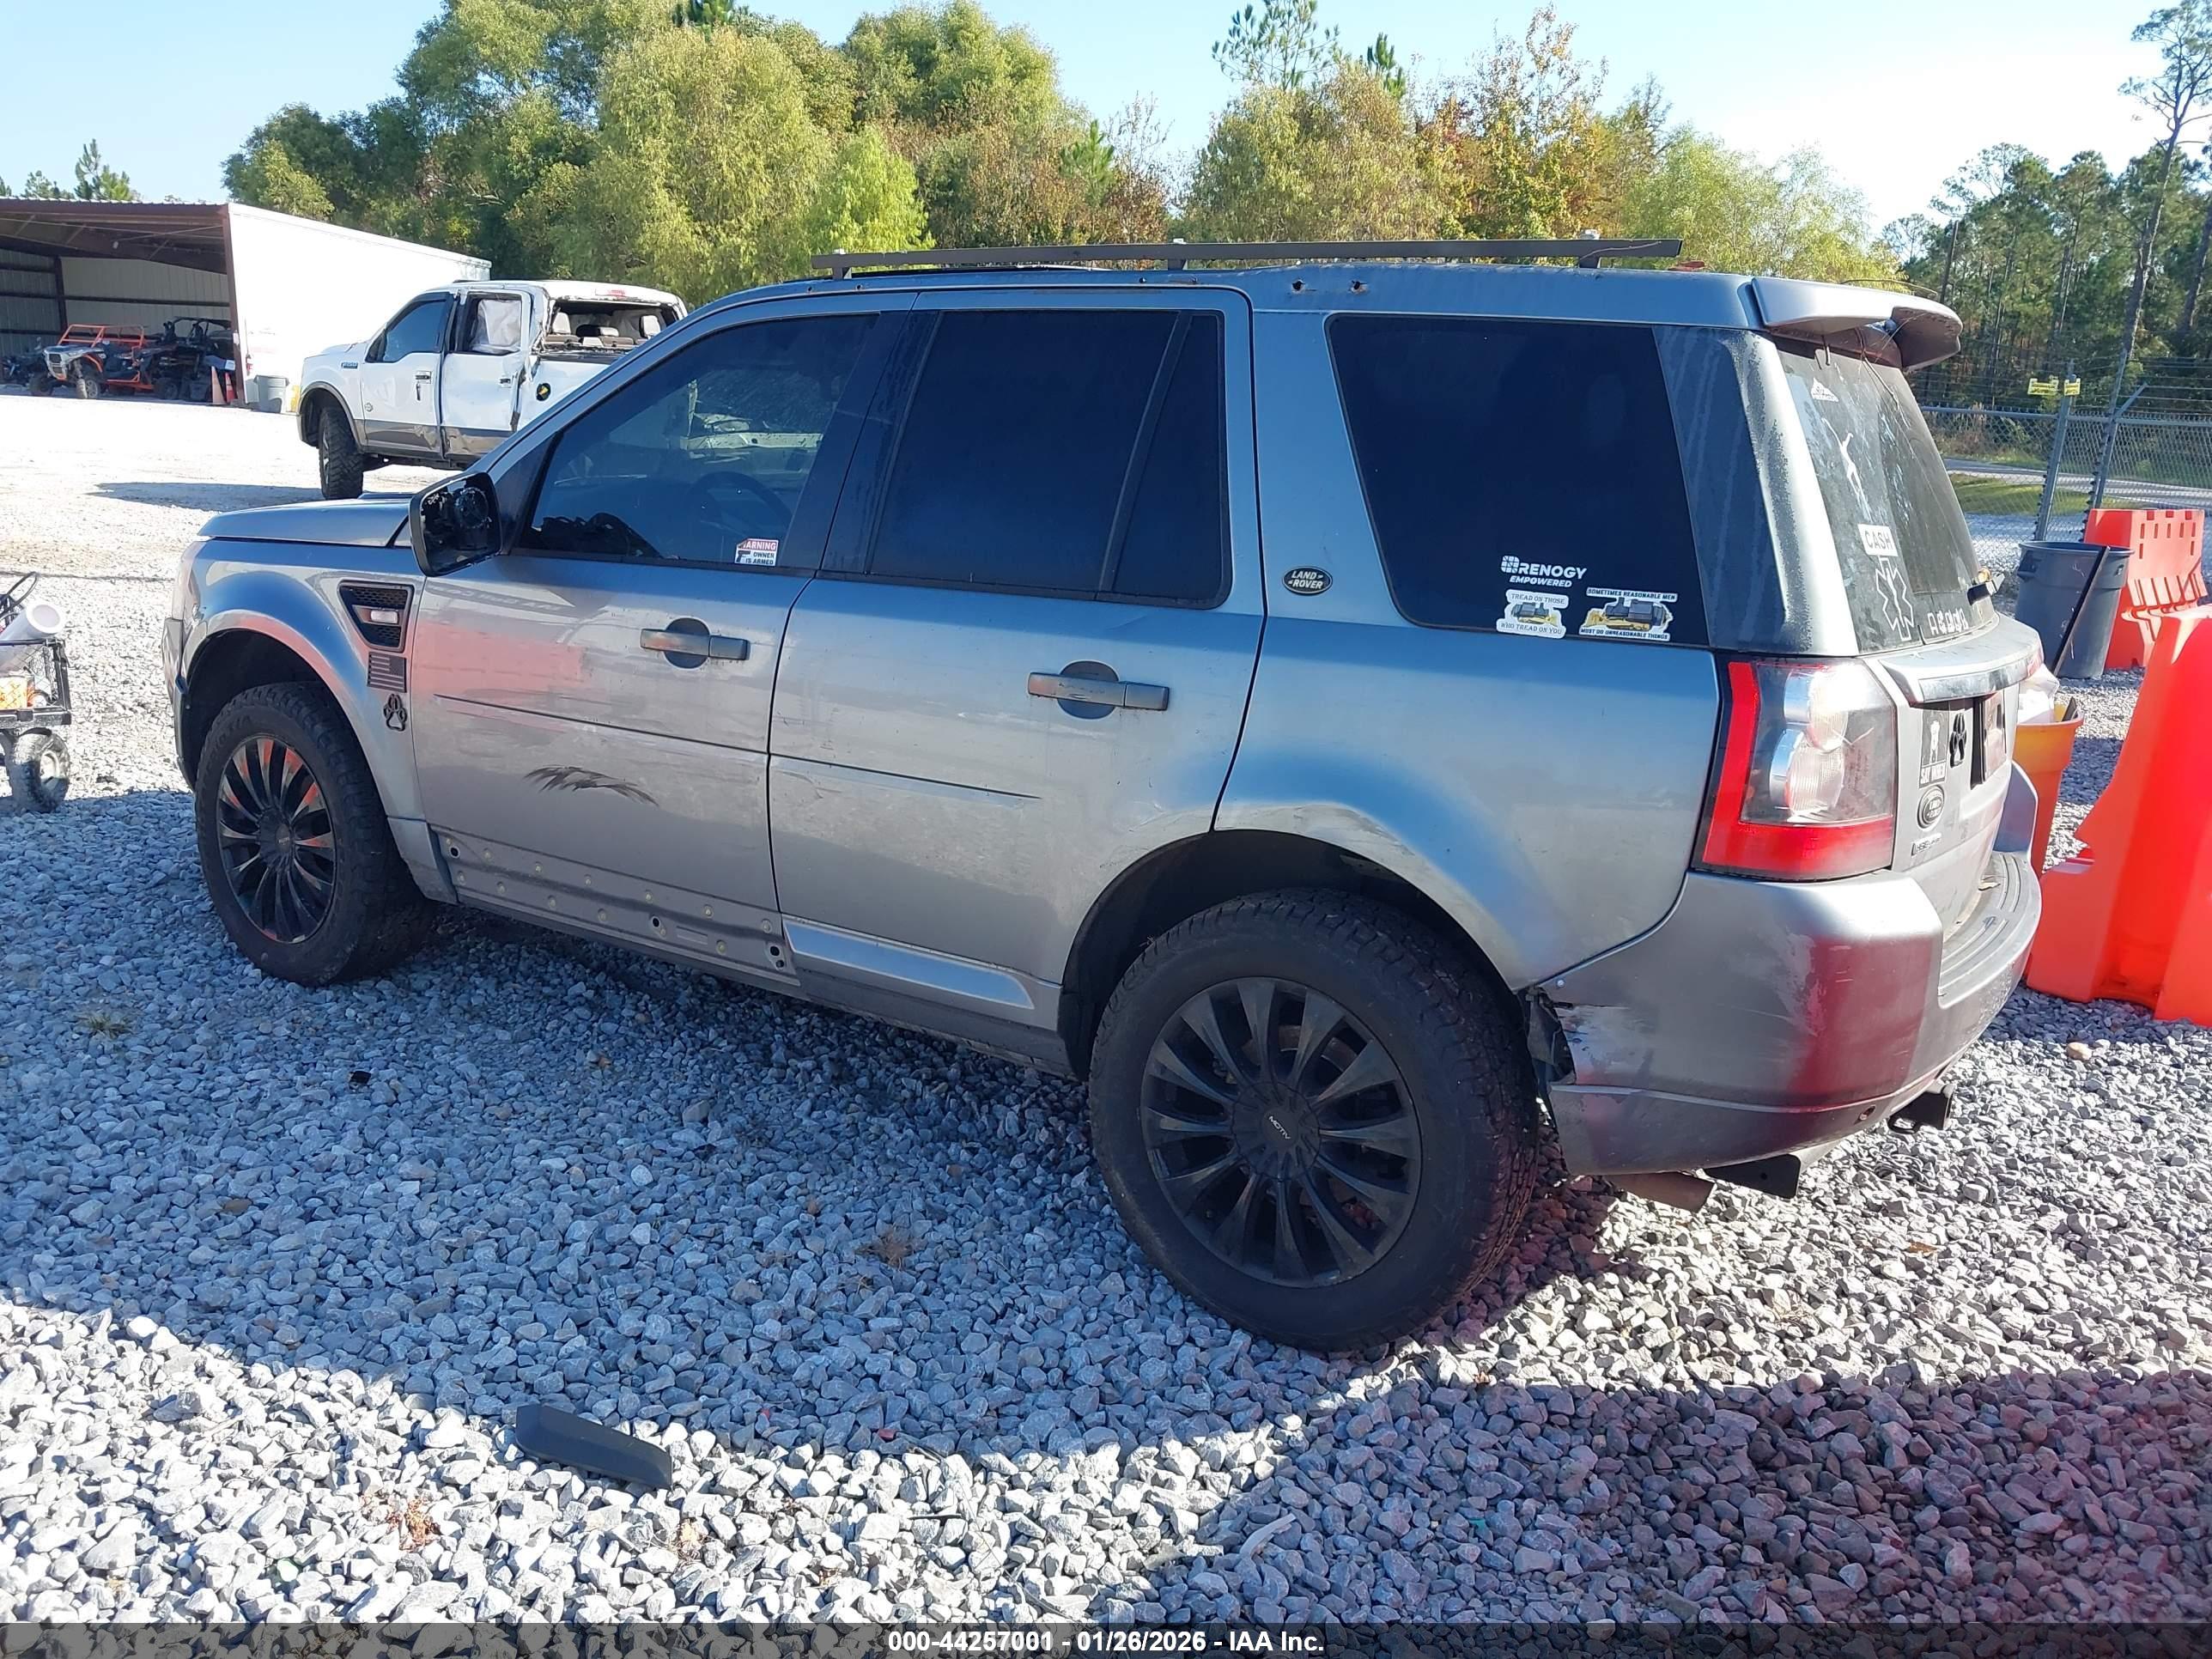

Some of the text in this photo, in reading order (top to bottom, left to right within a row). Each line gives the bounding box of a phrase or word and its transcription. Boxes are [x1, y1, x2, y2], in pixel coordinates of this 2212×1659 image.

[1864, 530, 1893, 550] CASH
[1291, 570, 1317, 580] LAND
[1517, 562, 1588, 580] RENOGY
[1291, 579, 1323, 589] ROVER
[1509, 575, 1573, 587] EMPOWERED
[1511, 592, 1534, 601] TREAD
[1587, 588, 1622, 597] SOMETIMES
[1623, 591, 1661, 599] REASONABLE
[1516, 623, 1538, 632] TREAD
[1268, 1115, 1291, 1139] MOTIV
